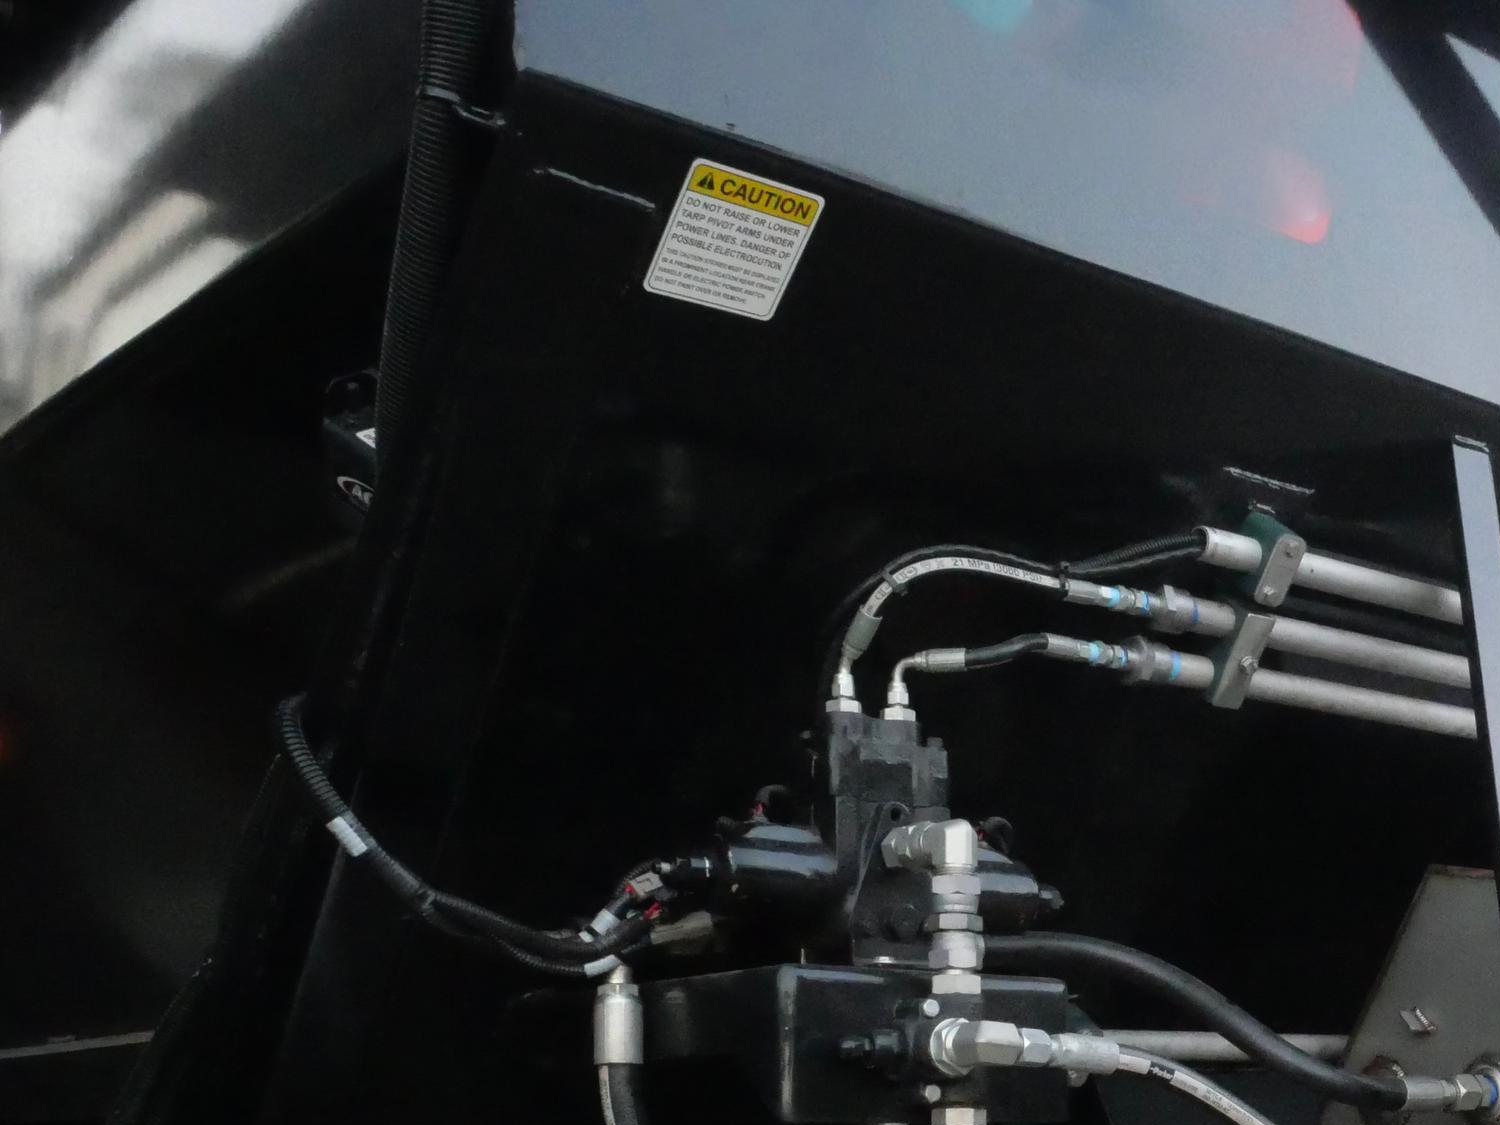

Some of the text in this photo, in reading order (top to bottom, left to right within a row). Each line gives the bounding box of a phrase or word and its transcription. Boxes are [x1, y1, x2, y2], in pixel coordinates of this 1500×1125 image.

[686, 196, 800, 237] DO NOT RAISE OR LOWER
[720, 179, 812, 219] CAUTION
[671, 232, 712, 251] POSSIBLE
[676, 220, 709, 237] POWER
[740, 239, 776, 256] DANGER
[778, 250, 790, 260] OF
[681, 208, 794, 248] TARP PIVOT ARMS UNDER
[952, 558, 964, 567] 21
[967, 559, 990, 571] MPa
